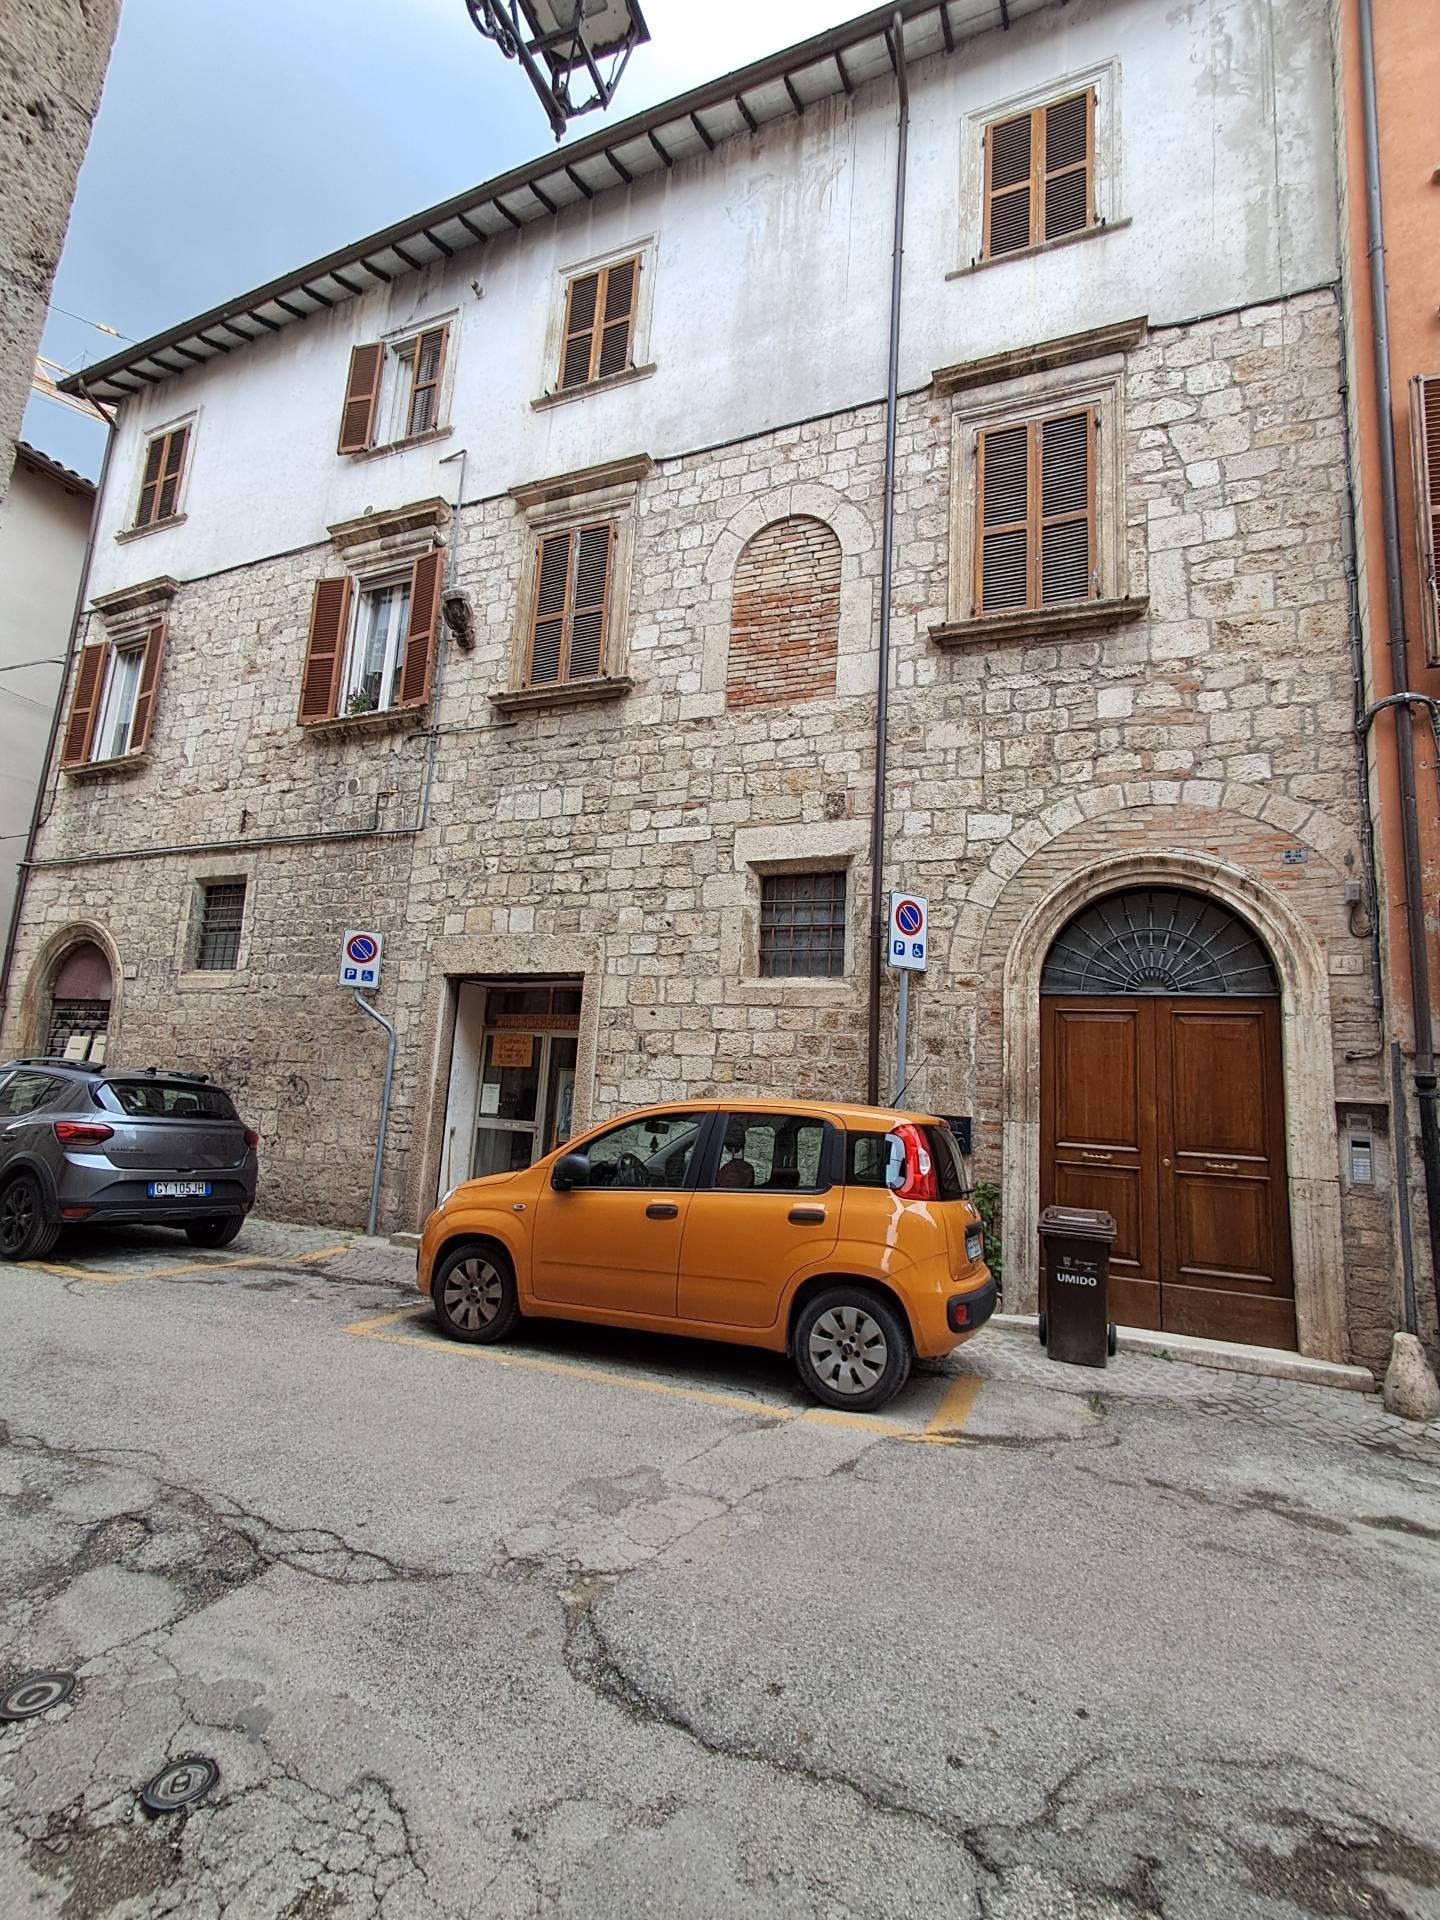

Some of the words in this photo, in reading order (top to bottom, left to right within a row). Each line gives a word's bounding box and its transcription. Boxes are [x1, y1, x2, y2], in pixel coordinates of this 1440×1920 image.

[156, 1182, 169, 1194] GY
[174, 1182, 204, 1194] 105JH
[1057, 1272, 1097, 1287] UMIDO
